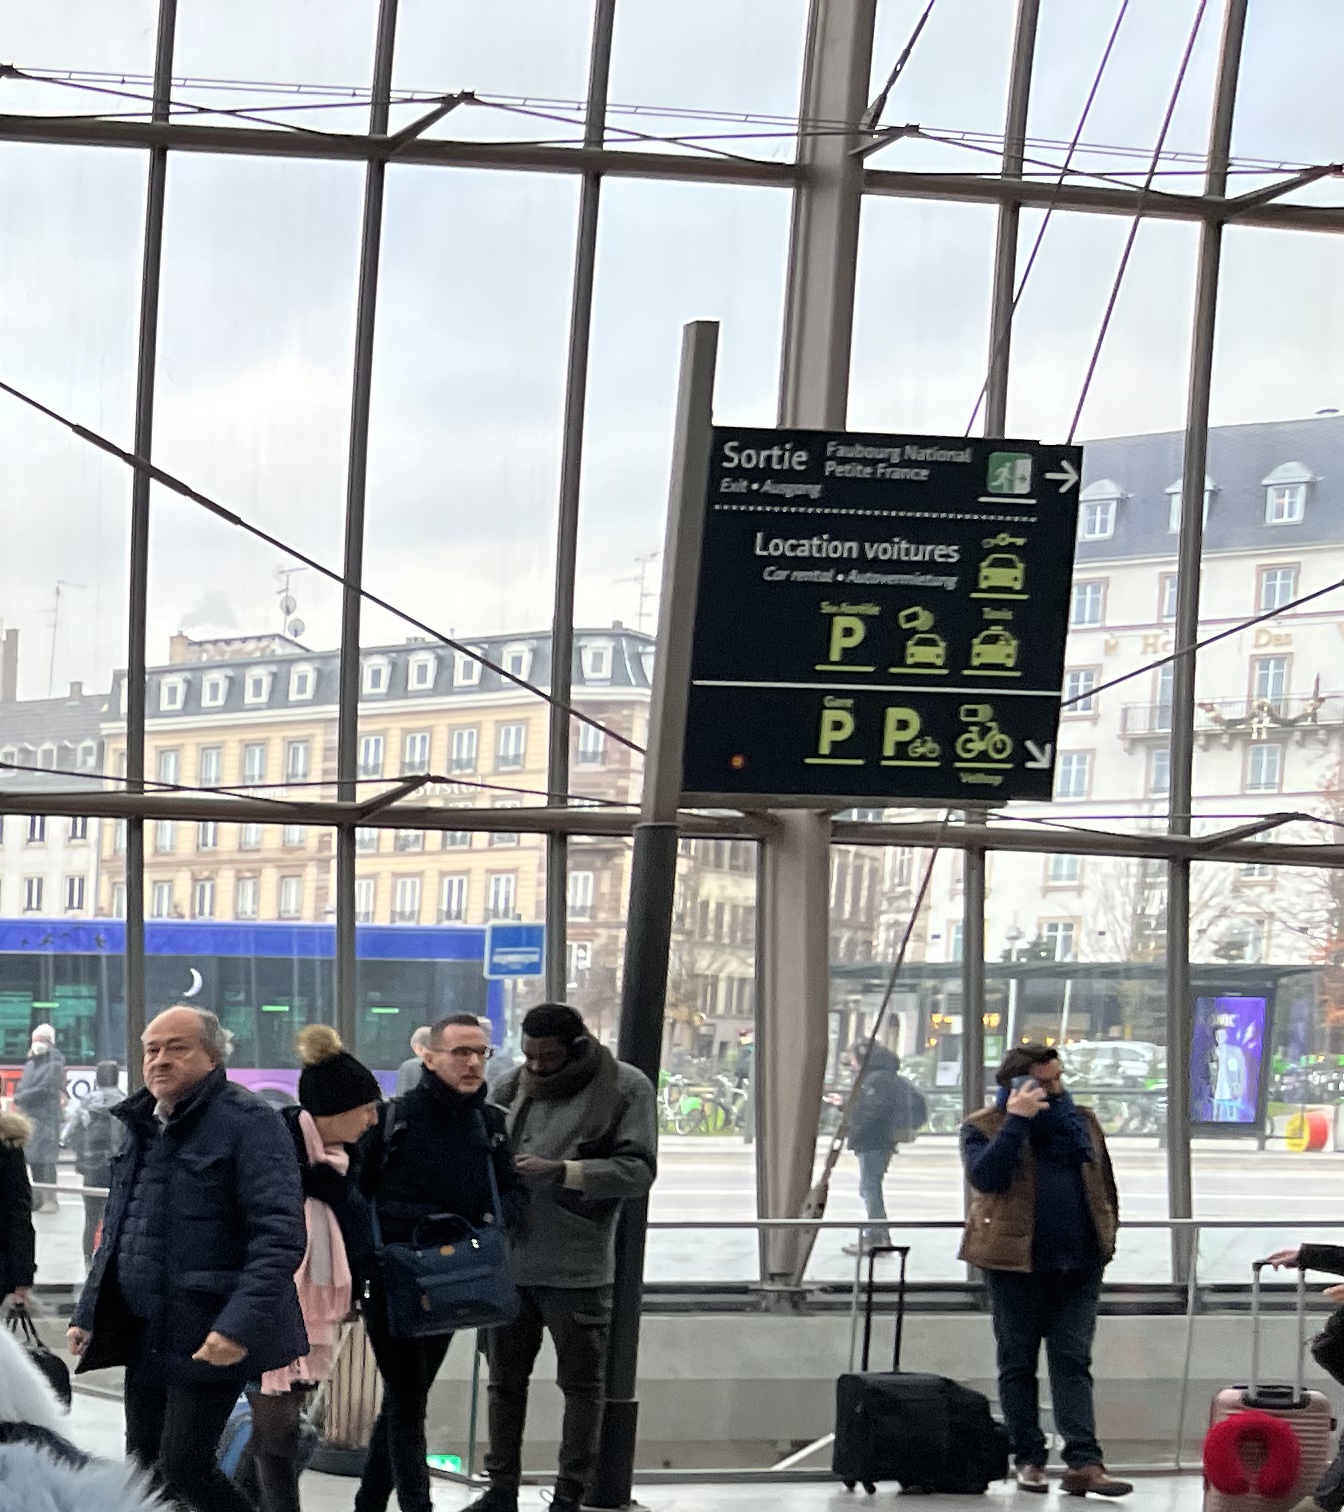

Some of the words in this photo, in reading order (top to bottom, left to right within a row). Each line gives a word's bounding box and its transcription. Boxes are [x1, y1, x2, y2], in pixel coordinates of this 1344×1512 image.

[722, 440, 810, 471] Sortie
[826, 441, 902, 463] Faubourg
[904, 444, 973, 463] National
[824, 460, 874, 478] Petite
[875, 463, 930, 481] France
[720, 477, 749, 493] Exit
[754, 531, 860, 559] Location
[864, 536, 961, 564] voitures
